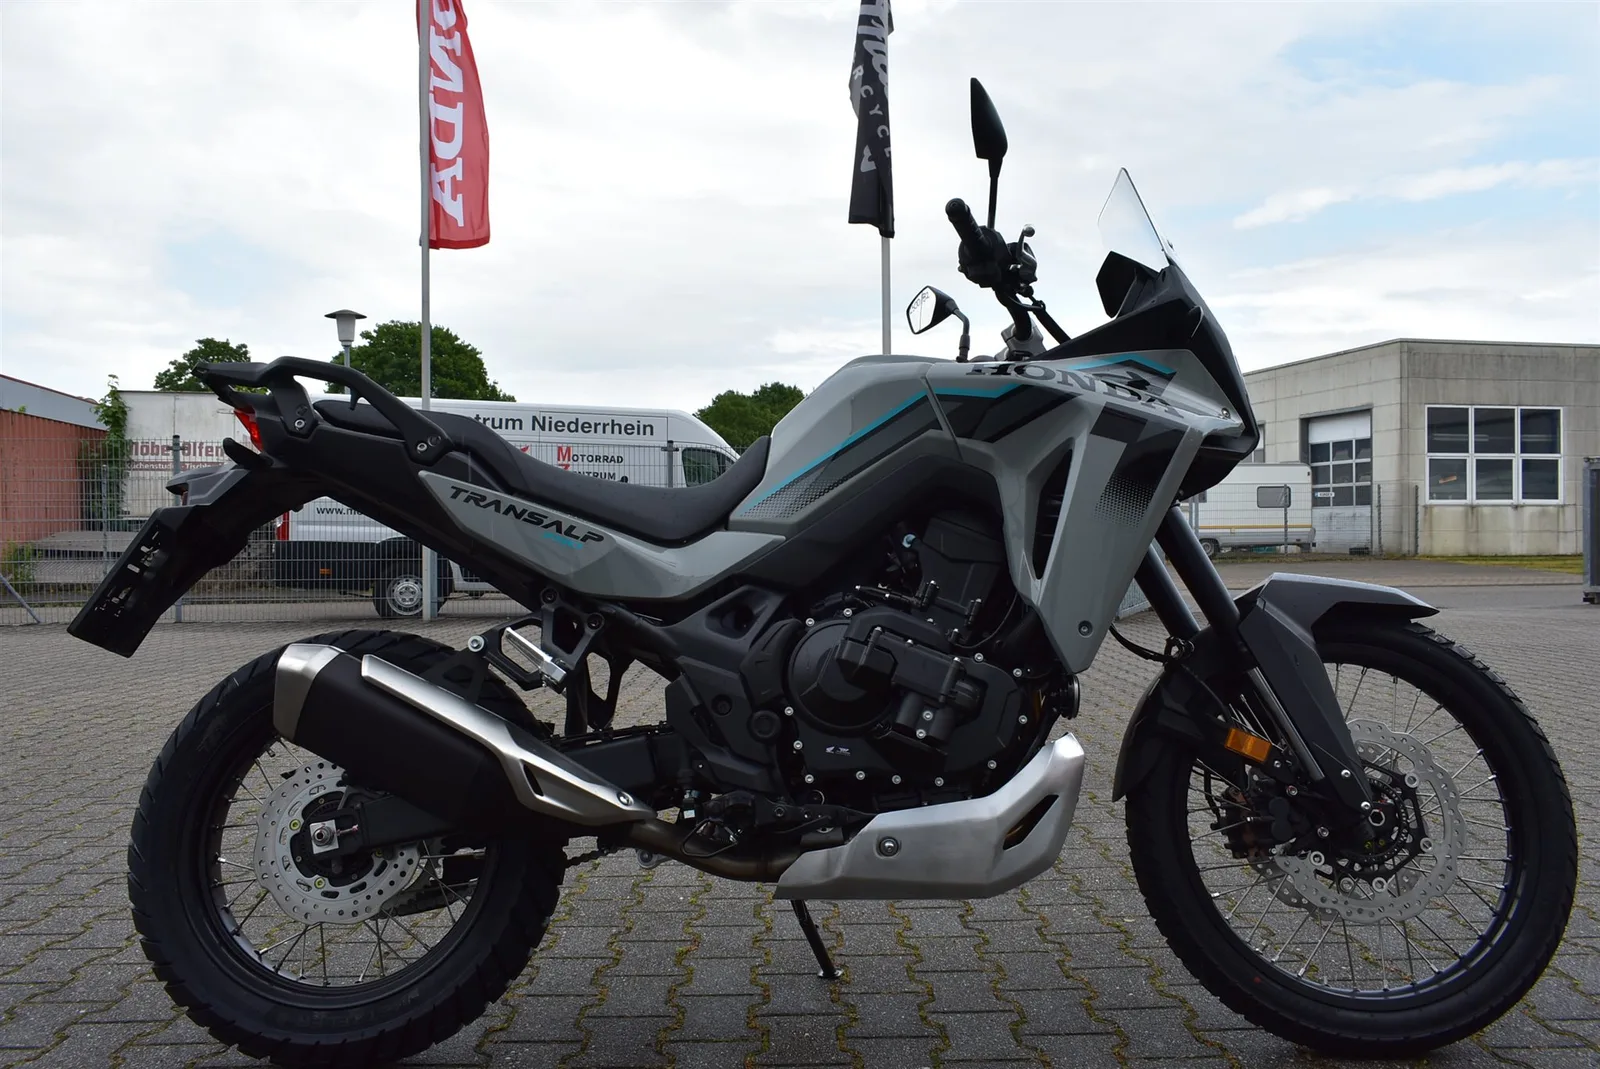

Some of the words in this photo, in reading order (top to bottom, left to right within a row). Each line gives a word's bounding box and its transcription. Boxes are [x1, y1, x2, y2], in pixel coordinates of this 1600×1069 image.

[965, 362, 1185, 419] HONDA
[474, 413, 523, 431] trum
[531, 415, 654, 436] Niederrhein
[557, 446, 624, 464] MOTORRAD
[450, 486, 605, 543] TRANSALP
